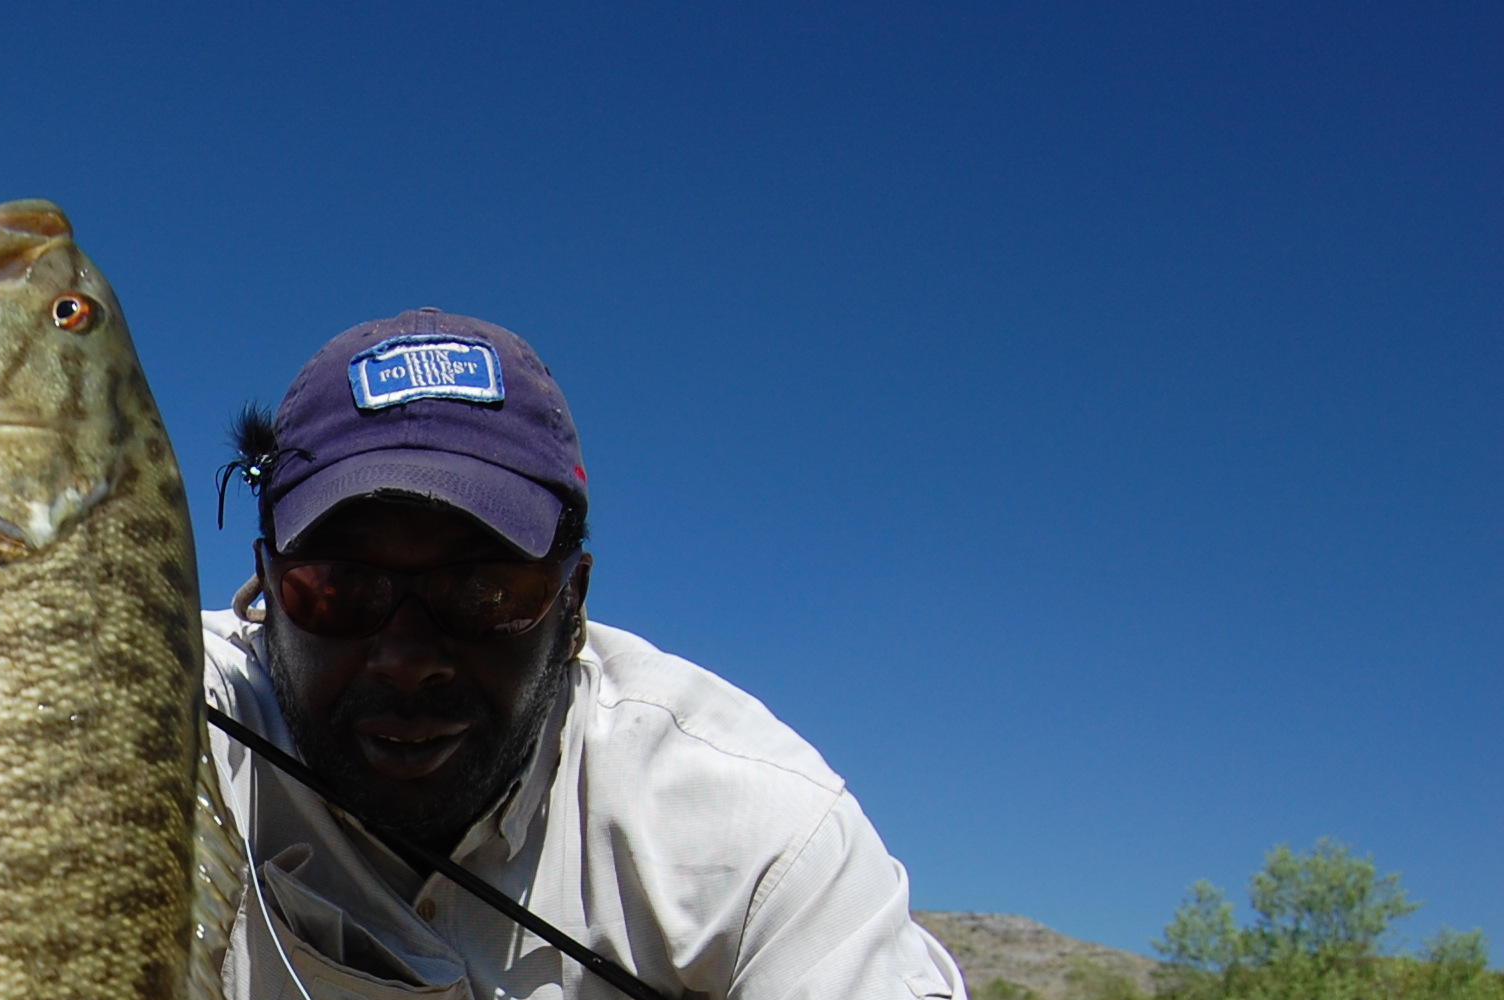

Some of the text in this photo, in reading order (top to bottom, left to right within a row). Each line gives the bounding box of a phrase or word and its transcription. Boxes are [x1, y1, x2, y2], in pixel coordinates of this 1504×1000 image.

[404, 351, 449, 364] RUN
[379, 361, 478, 382] FORREST
[411, 372, 456, 386] RUN
